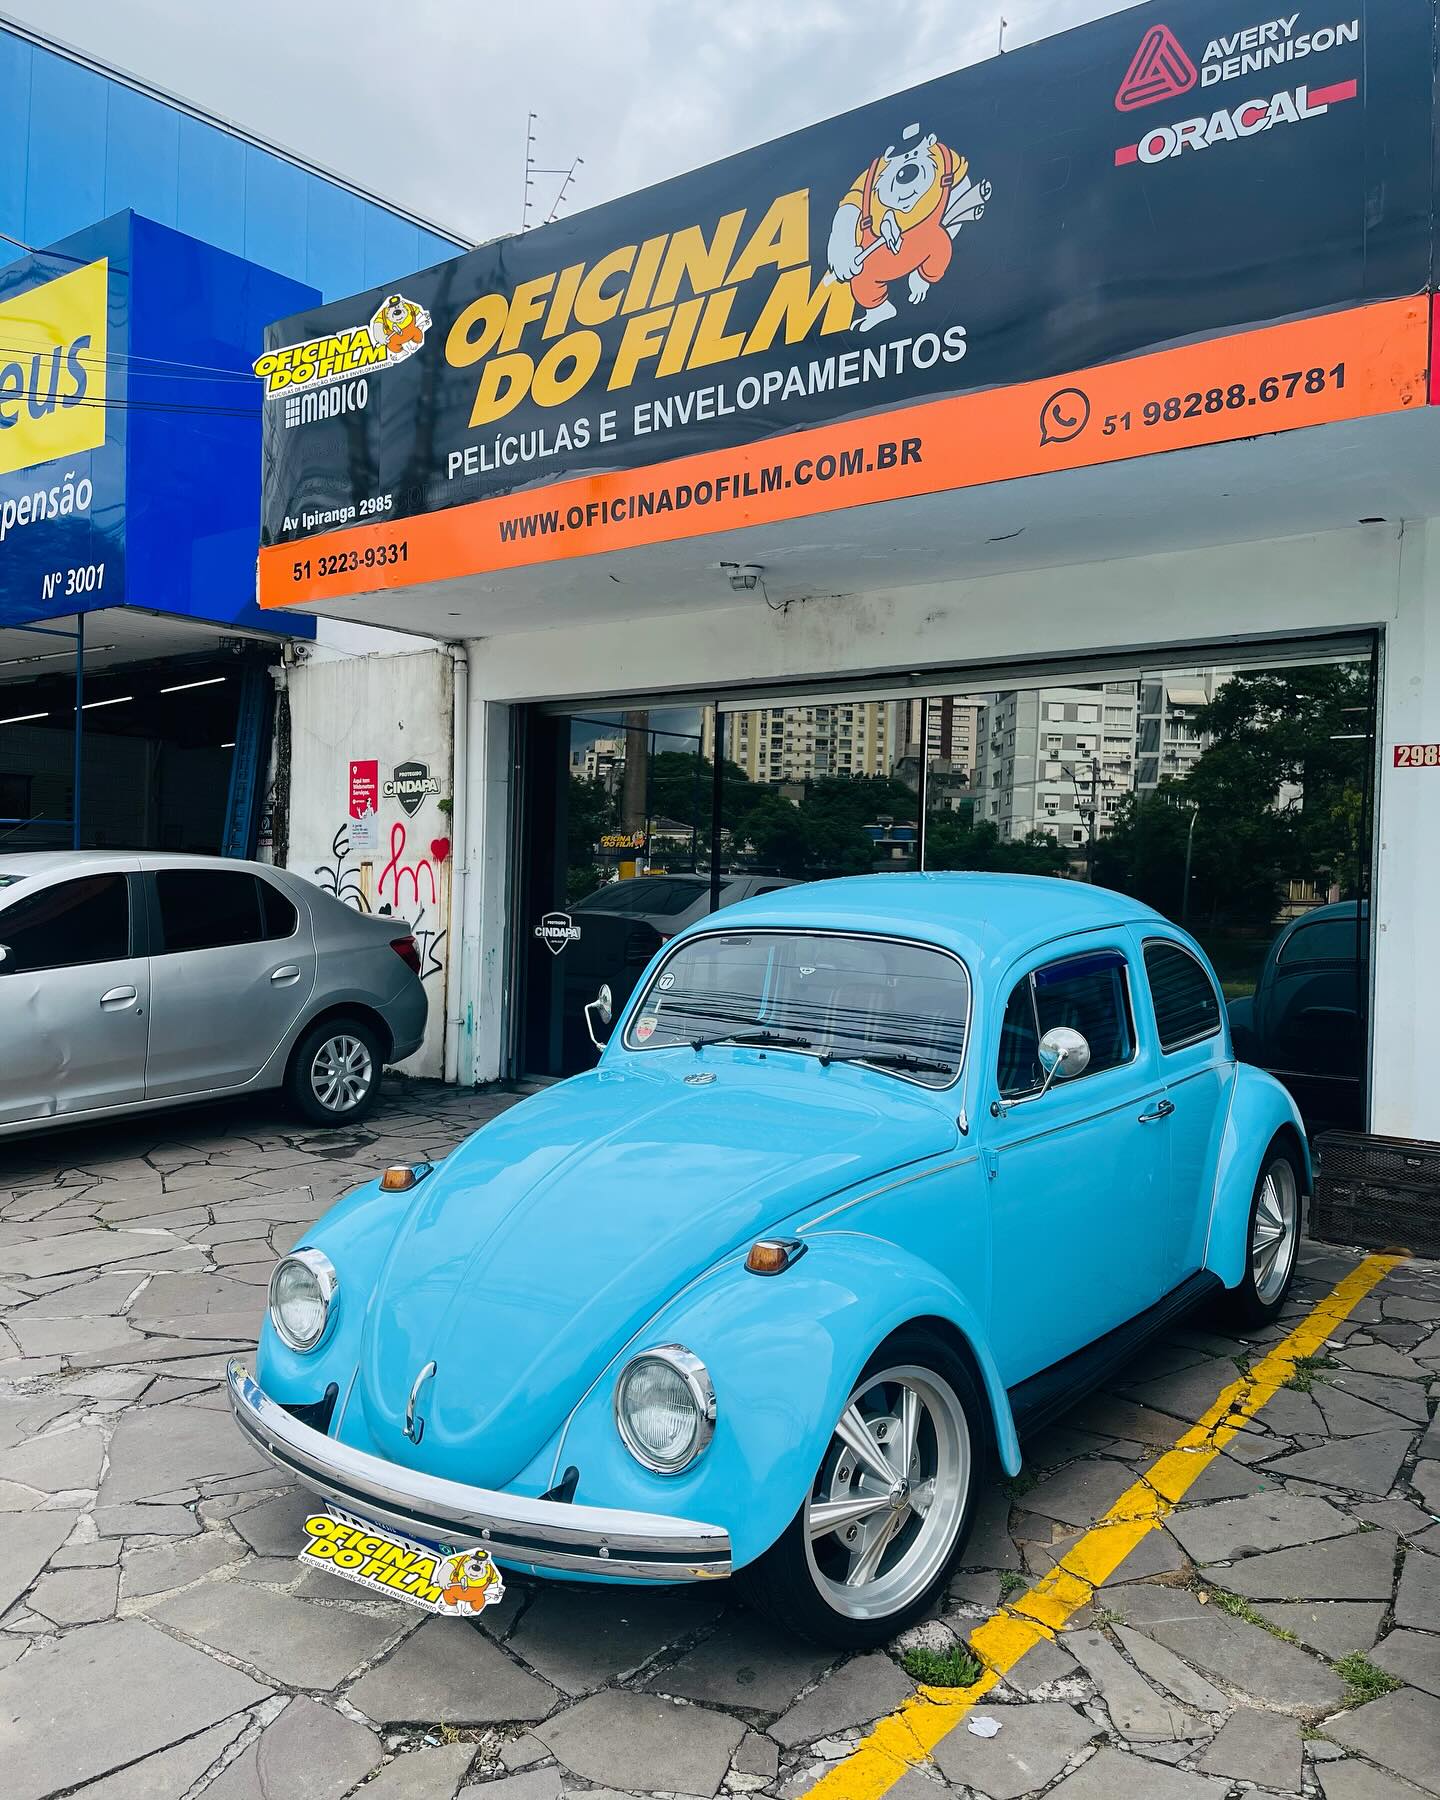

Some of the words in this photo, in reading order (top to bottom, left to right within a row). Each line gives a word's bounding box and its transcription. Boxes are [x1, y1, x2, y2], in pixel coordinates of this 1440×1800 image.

[1201, 13, 1300, 64] AVERY
[1201, 19, 1359, 88] DENNISON
[1137, 85, 1328, 164] ORACAL
[445, 187, 810, 369] OFICINA
[468, 329, 602, 429] DO
[607, 266, 856, 393] FILM
[301, 379, 368, 425] MADICO
[448, 413, 591, 480] PELÍCULAS
[600, 411, 617, 444] E
[634, 325, 967, 436] ENVELOPAMENTOS
[1102, 411, 1131, 436] 51
[1143, 362, 1346, 426] 98288.6781
[0, 470, 93, 541] pensão
[282, 515, 299, 532] Av
[302, 504, 356, 531] Ipiranga
[359, 494, 393, 516] 2985
[499, 437, 923, 543] WWW.OFICINADOFILM.COM.BR
[65, 563, 105, 596] 3001
[293, 561, 311, 582] 51
[318, 541, 408, 577] 3223-9331
[1397, 745, 1440, 767] 298
[383, 778, 439, 796] CINDAPA
[535, 926, 579, 938] CINDAPA
